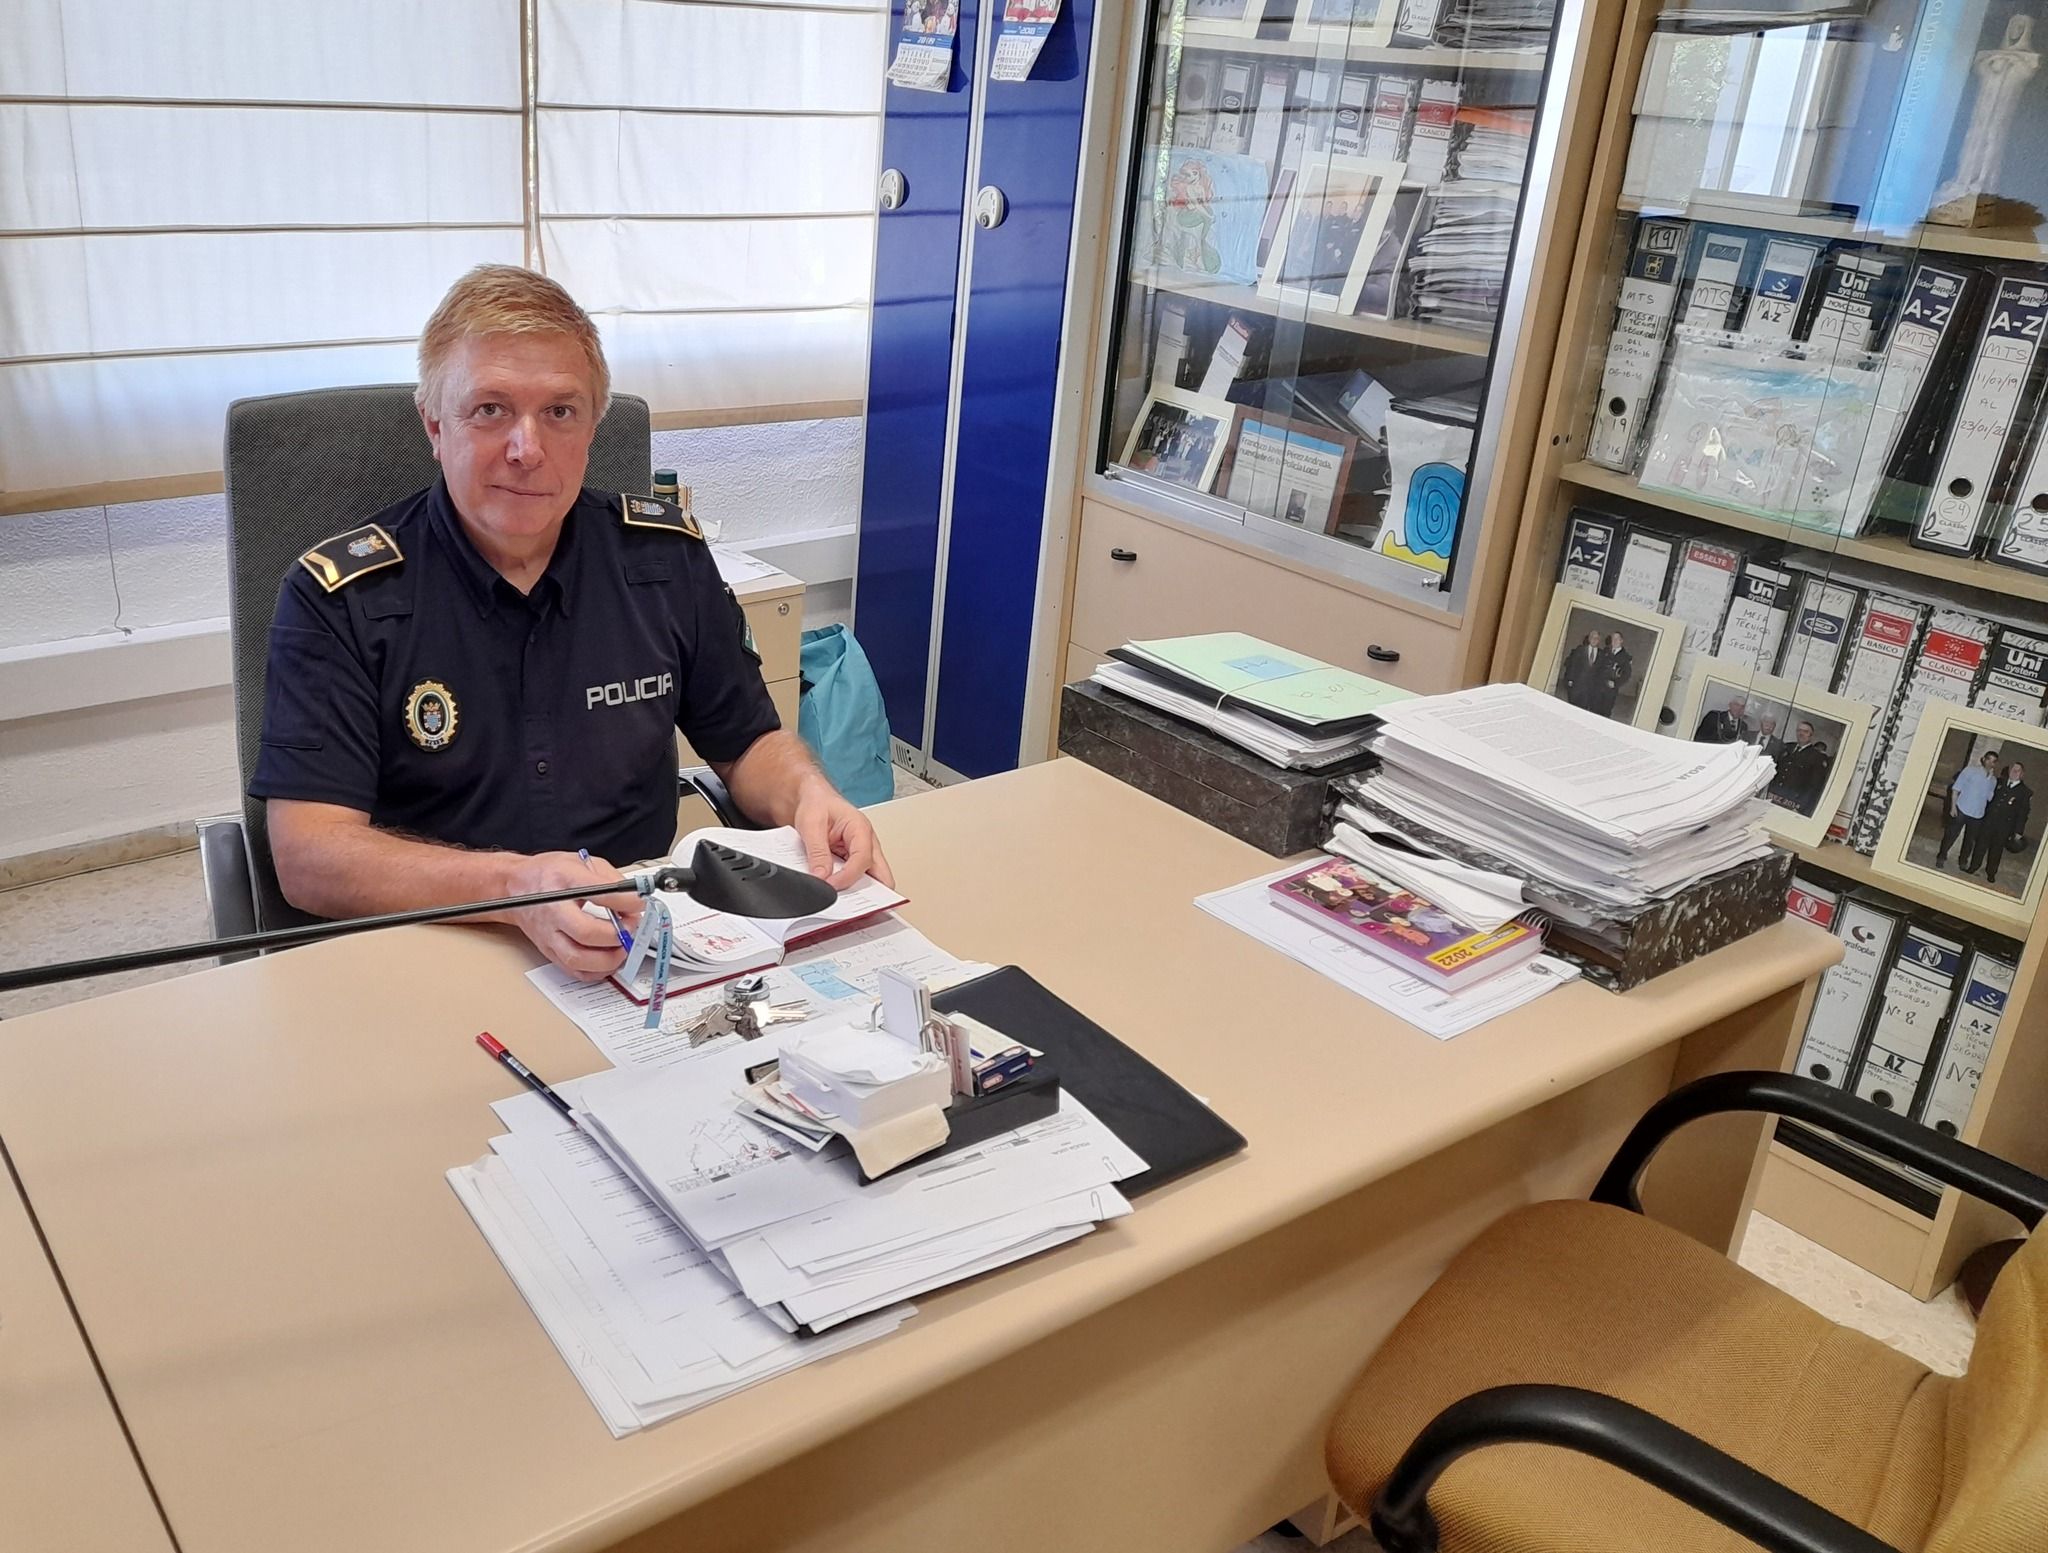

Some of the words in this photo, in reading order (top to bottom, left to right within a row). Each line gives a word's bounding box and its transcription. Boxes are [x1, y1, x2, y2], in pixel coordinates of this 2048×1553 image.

[1840, 271, 1870, 292] Uni
[1626, 291, 1655, 305] MTS
[1694, 287, 1731, 307] MTS
[1757, 298, 1792, 314] MTS
[1904, 299, 1950, 325] A-Z
[1821, 316, 1862, 337] MTS
[1991, 311, 2043, 336] A-Z
[1899, 328, 1938, 348] MTS
[1984, 342, 2028, 361] MTS
[1569, 545, 1606, 567] A-Z
[1692, 549, 1728, 568] ESSELTE
[1866, 640, 1899, 654] BASICO
[1928, 660, 1967, 678] CLASICO
[2006, 648, 2044, 672] Uni
[2004, 663, 2039, 679] system
[586, 672, 674, 710] POLICIA
[1994, 675, 2040, 695] NOVOCLAS
[1983, 697, 2026, 717] MESA
[1440, 948, 1473, 967] 2022
[1884, 1053, 1906, 1074] AZ
